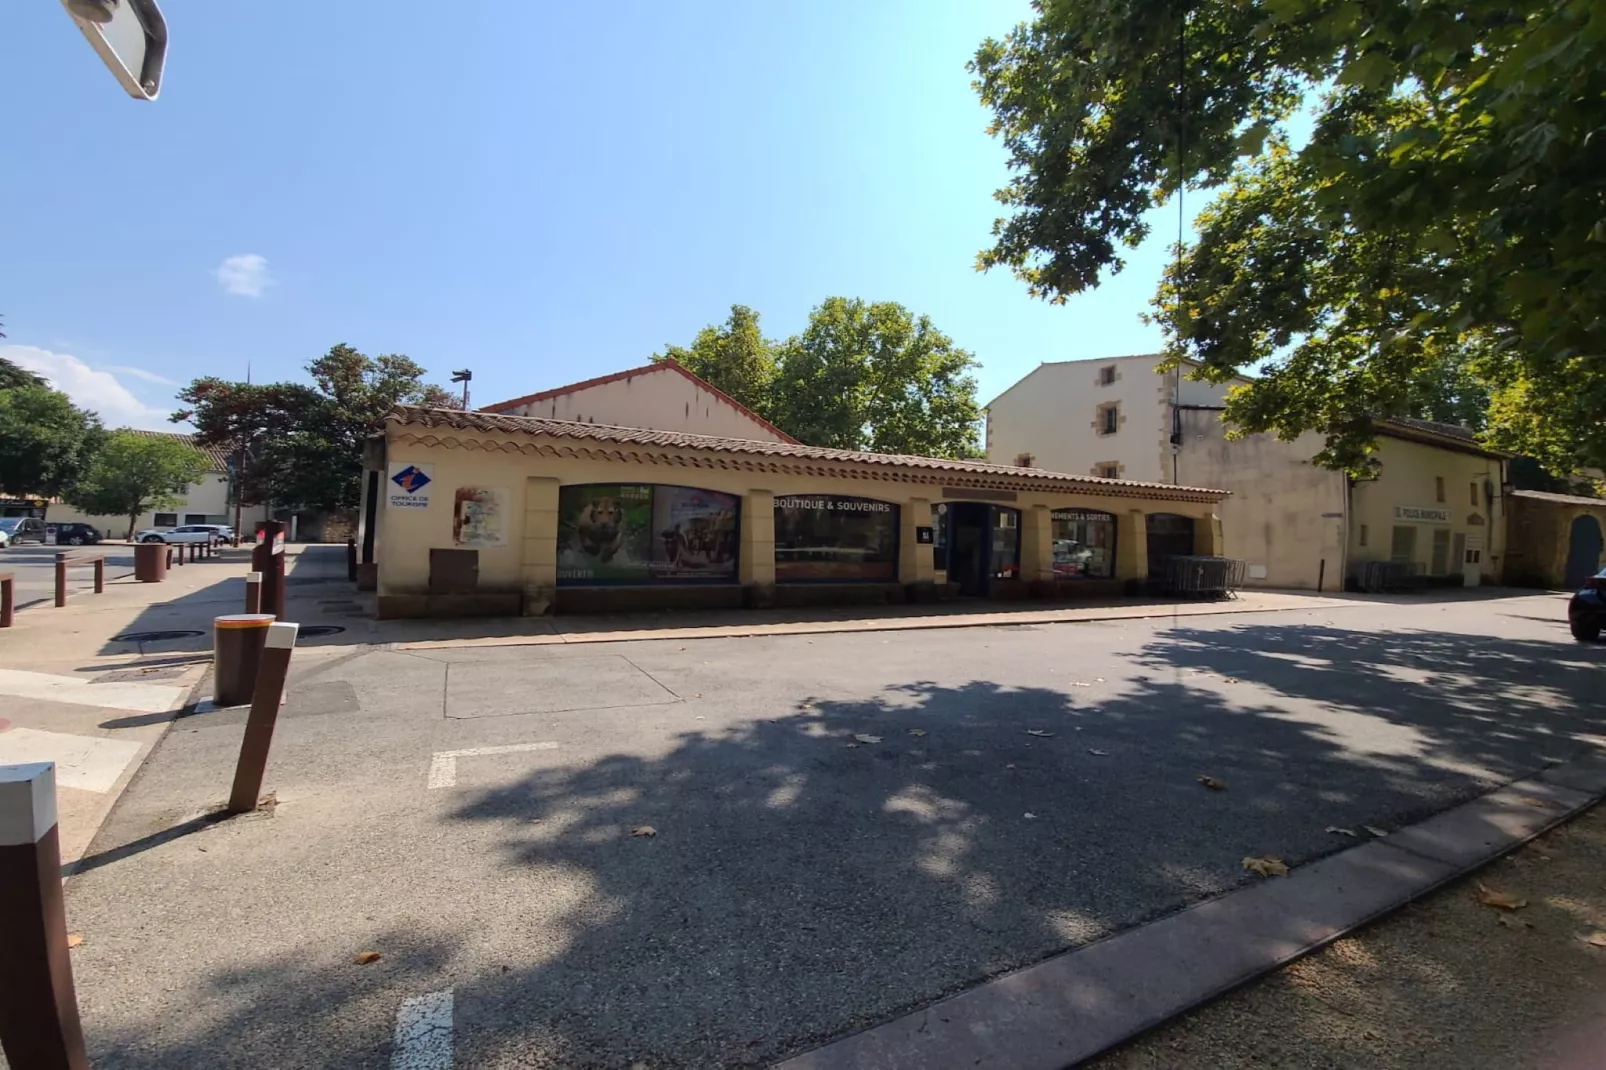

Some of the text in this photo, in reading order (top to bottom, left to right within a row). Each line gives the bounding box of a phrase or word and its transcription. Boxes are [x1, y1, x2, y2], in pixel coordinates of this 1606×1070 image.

[773, 499, 891, 512] BOUTIQUE & SOUVENIRS
[1086, 513, 1111, 521] SORTIES
[1402, 508, 1420, 518] POLICE
[1421, 510, 1446, 520] MUNICIPALE
